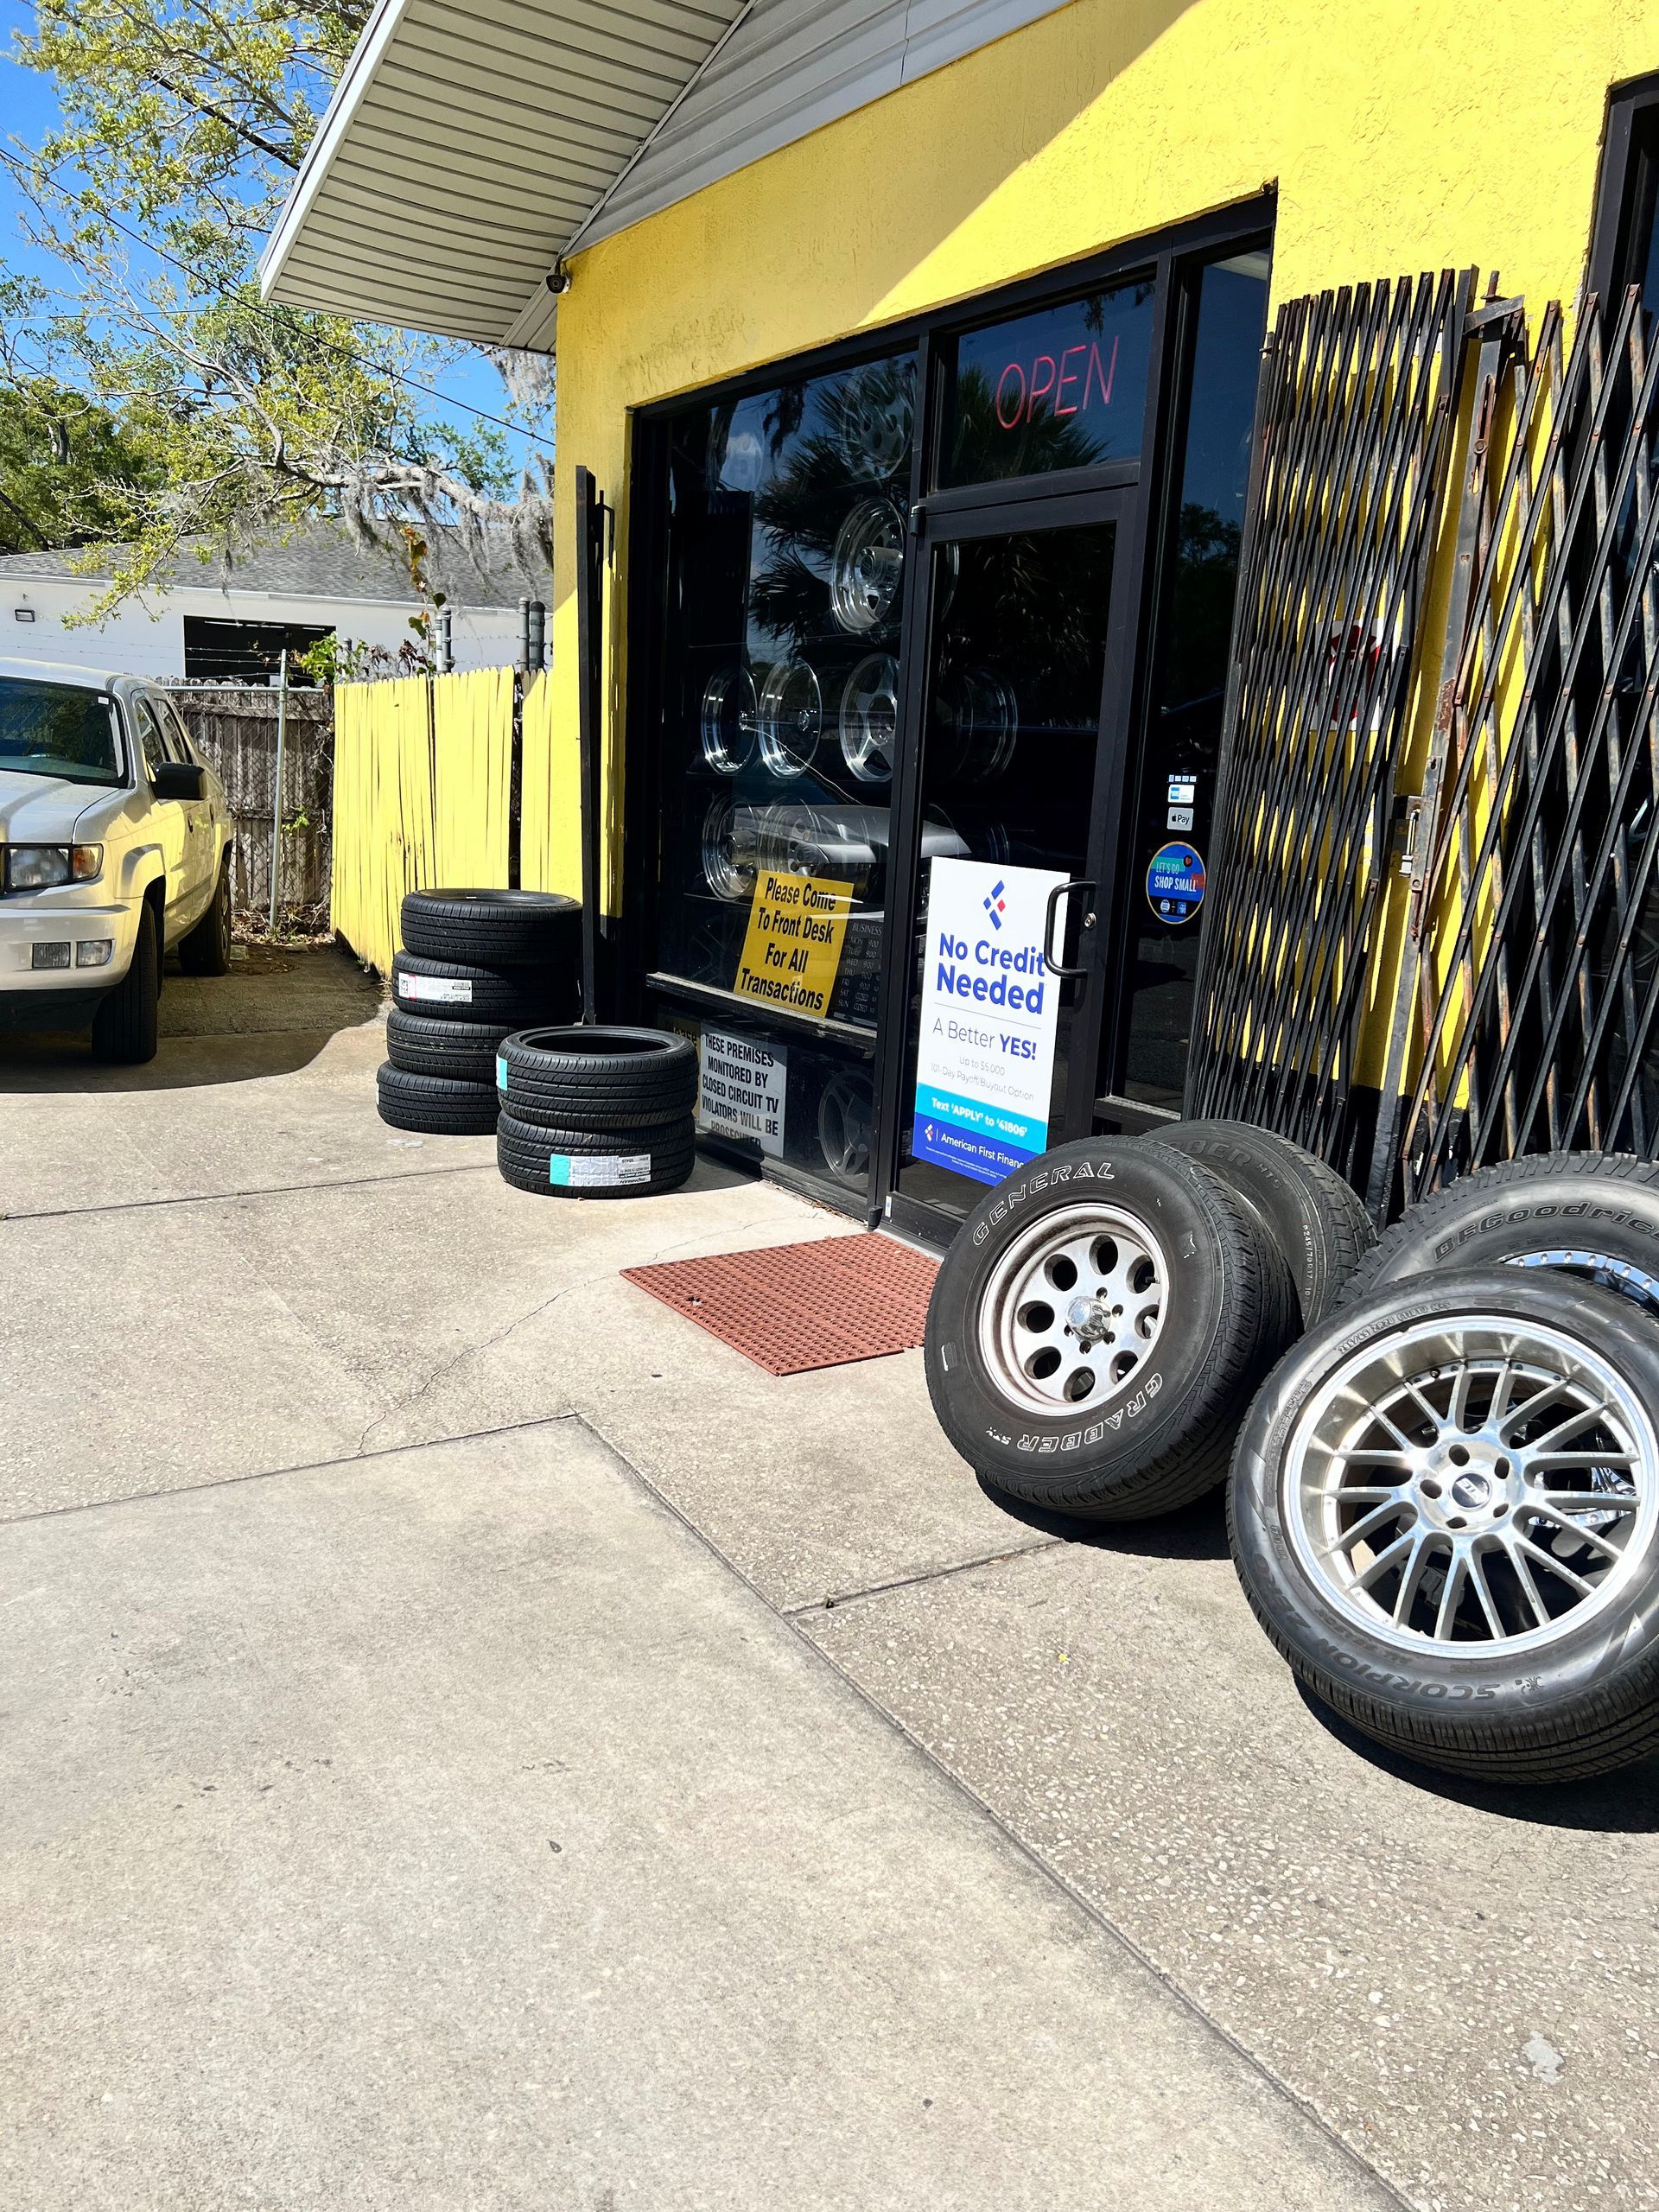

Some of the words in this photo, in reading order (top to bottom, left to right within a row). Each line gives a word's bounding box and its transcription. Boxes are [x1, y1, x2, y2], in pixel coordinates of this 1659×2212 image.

[996, 335, 1119, 429] OPEN
[1178, 814, 1190, 826] Pay
[1154, 875, 1173, 889] SHOP
[1174, 876, 1197, 893] SMALL
[1155, 861, 1170, 874] LET'S
[1171, 863, 1179, 874] GO
[765, 877, 800, 906] Please
[803, 882, 836, 912] Come
[757, 907, 771, 931] To
[772, 910, 802, 938] Front
[802, 915, 836, 944] Desk
[852, 922, 882, 937] BUSINESS
[765, 942, 788, 967] For
[788, 948, 810, 973] All
[939, 932, 969, 960] No
[975, 940, 1046, 977] Credit
[741, 968, 824, 1011] Transactions
[937, 963, 1045, 1015] Needed
[704, 1033, 725, 1054] THESE
[727, 1040, 774, 1068] PREMISES
[932, 1017, 944, 1036] A
[948, 1020, 995, 1049] Better
[1000, 1033, 1037, 1061] YES!
[708, 1055, 752, 1084] MONITORED
[754, 1071, 768, 1089] BY
[959, 1056, 970, 1068] Up
[970, 1058, 979, 1069] to
[980, 1060, 1006, 1077] $5,000
[702, 1073, 726, 1097] CLOSED
[728, 1084, 764, 1109] CIRCUIT
[766, 1096, 779, 1114] TV
[957, 1071, 1007, 1095] Payoff/Buyout
[1007, 1084, 1034, 1103] Option
[702, 1094, 738, 1123] VIOLATORS
[740, 1109, 762, 1132] WILL
[765, 1117, 779, 1136] BE
[931, 1097, 950, 1113] Text
[951, 1103, 984, 1123] 'APPLY'
[985, 1116, 995, 1127] to
[941, 1133, 977, 1154] American
[979, 1147, 996, 1160] First
[973, 1161, 1116, 1246] GENERAL
[1016, 1372, 1163, 1453] GRABBER
[985, 1426, 1013, 1446] STX
[1317, 1637, 1502, 1701] SCORPION
